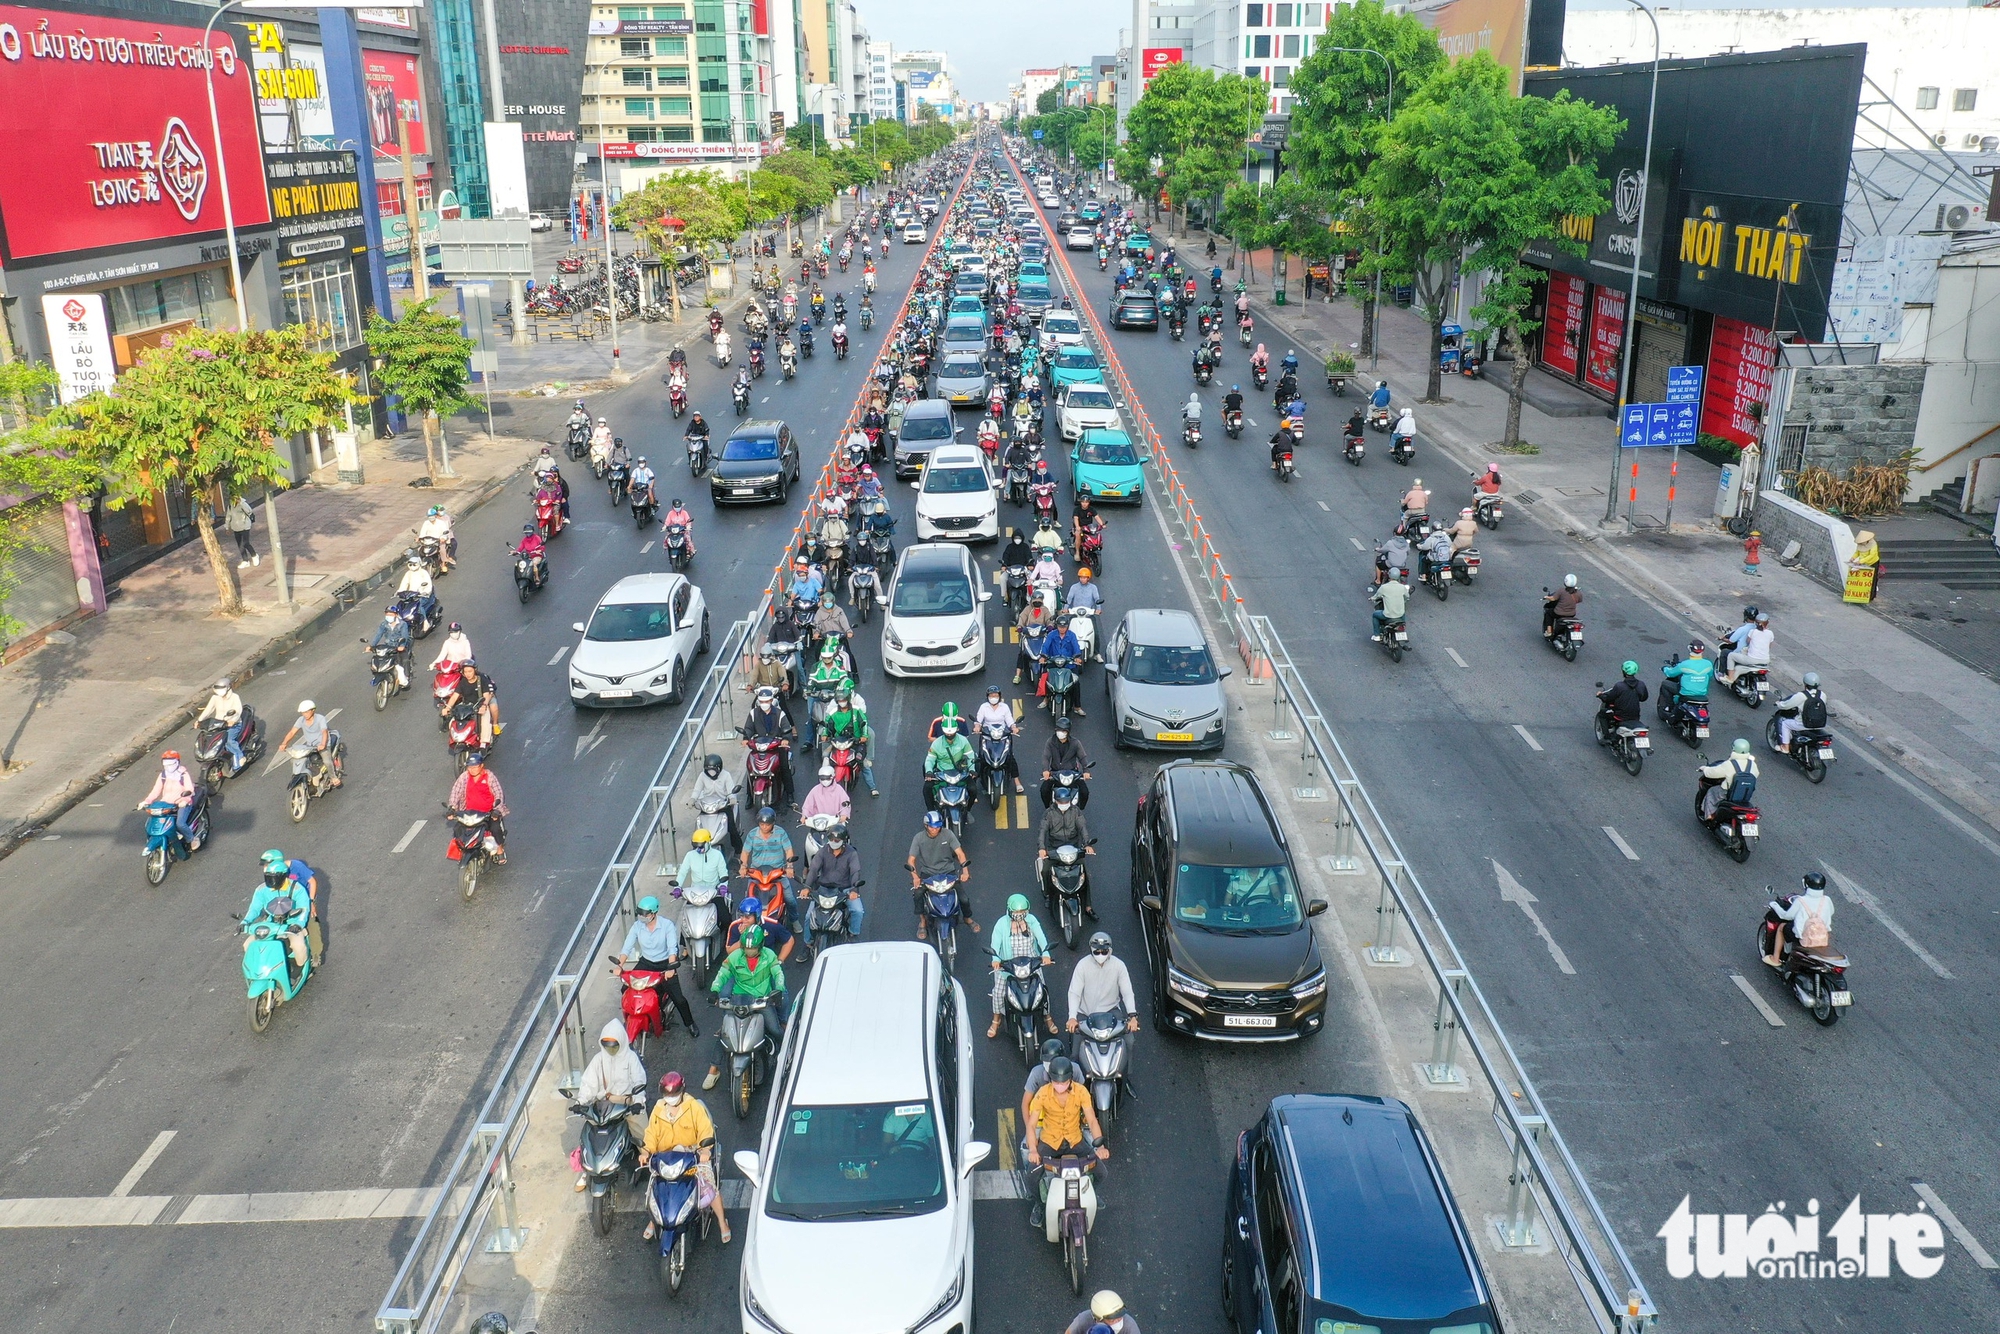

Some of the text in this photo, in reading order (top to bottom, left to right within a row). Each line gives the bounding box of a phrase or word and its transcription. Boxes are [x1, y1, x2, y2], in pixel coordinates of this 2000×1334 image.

[27, 18, 64, 59] LẨU
[67, 28, 93, 61] BÒ
[134, 31, 176, 67] TRIỀU
[178, 41, 214, 70] CHÂU
[500, 45, 571, 55] LOTTE CINEMA
[529, 105, 566, 115] HOUSE
[523, 130, 575, 142] TTE Mart
[94, 142, 136, 168] TIAN
[138, 141, 155, 170] 天
[677, 146, 699, 155] PHỤC
[93, 178, 140, 206] LONG
[320, 181, 359, 212] LUXURY
[1680, 203, 1812, 285] NỘI THẤT
[43, 280, 54, 290] 103
[1597, 295, 1625, 321] THANH
[1597, 327, 1607, 343] GIÁ
[71, 341, 93, 354] LẨU
[76, 356, 93, 368] BÒ
